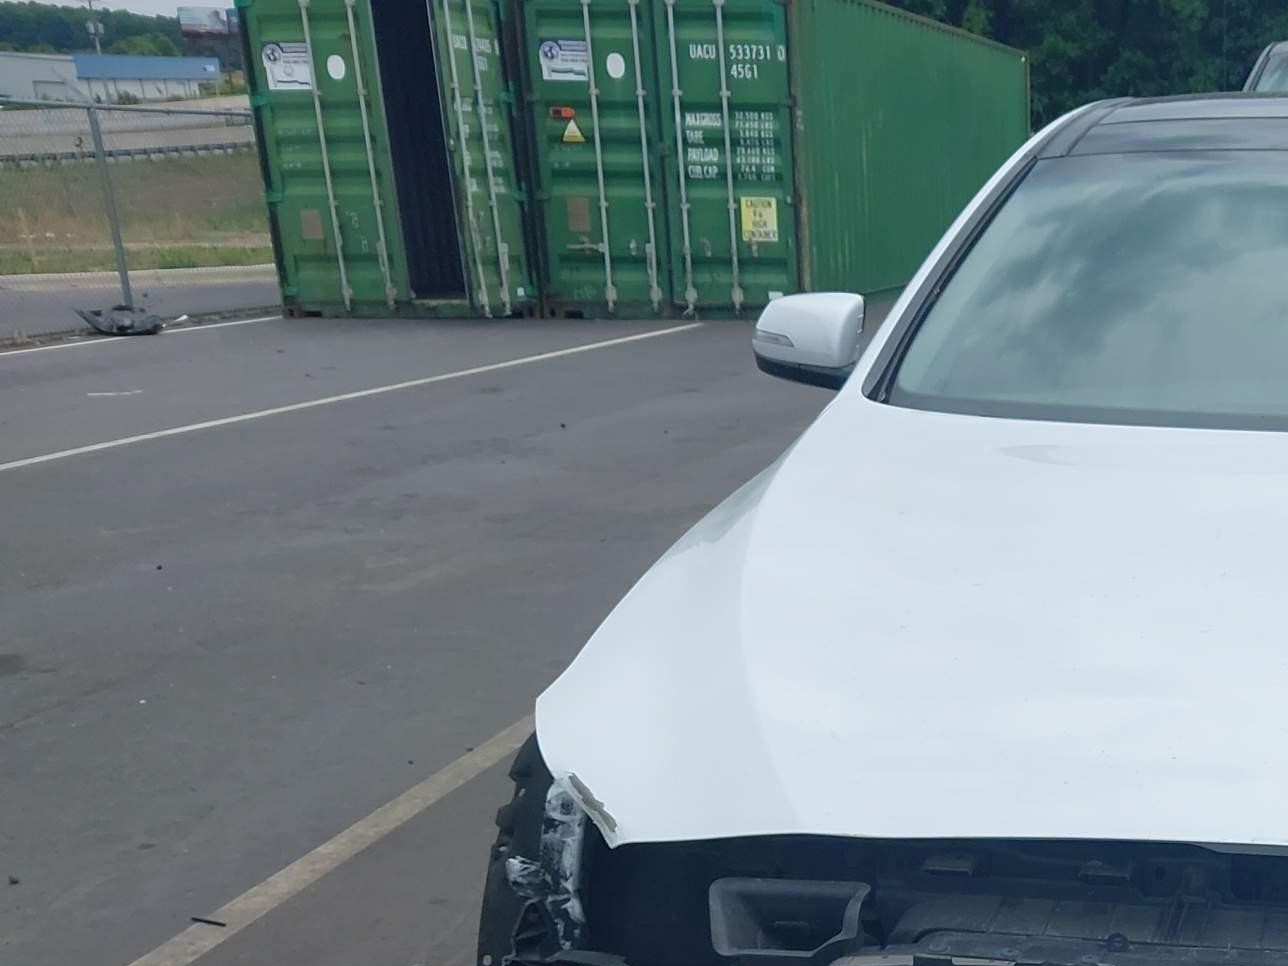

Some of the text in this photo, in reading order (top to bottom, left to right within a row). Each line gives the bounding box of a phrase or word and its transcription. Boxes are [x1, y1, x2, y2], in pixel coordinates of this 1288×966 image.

[689, 43, 716, 59] UACU
[729, 44, 770, 60] 533731
[730, 63, 758, 79] 45G1
[745, 199, 772, 208] CAUTION
